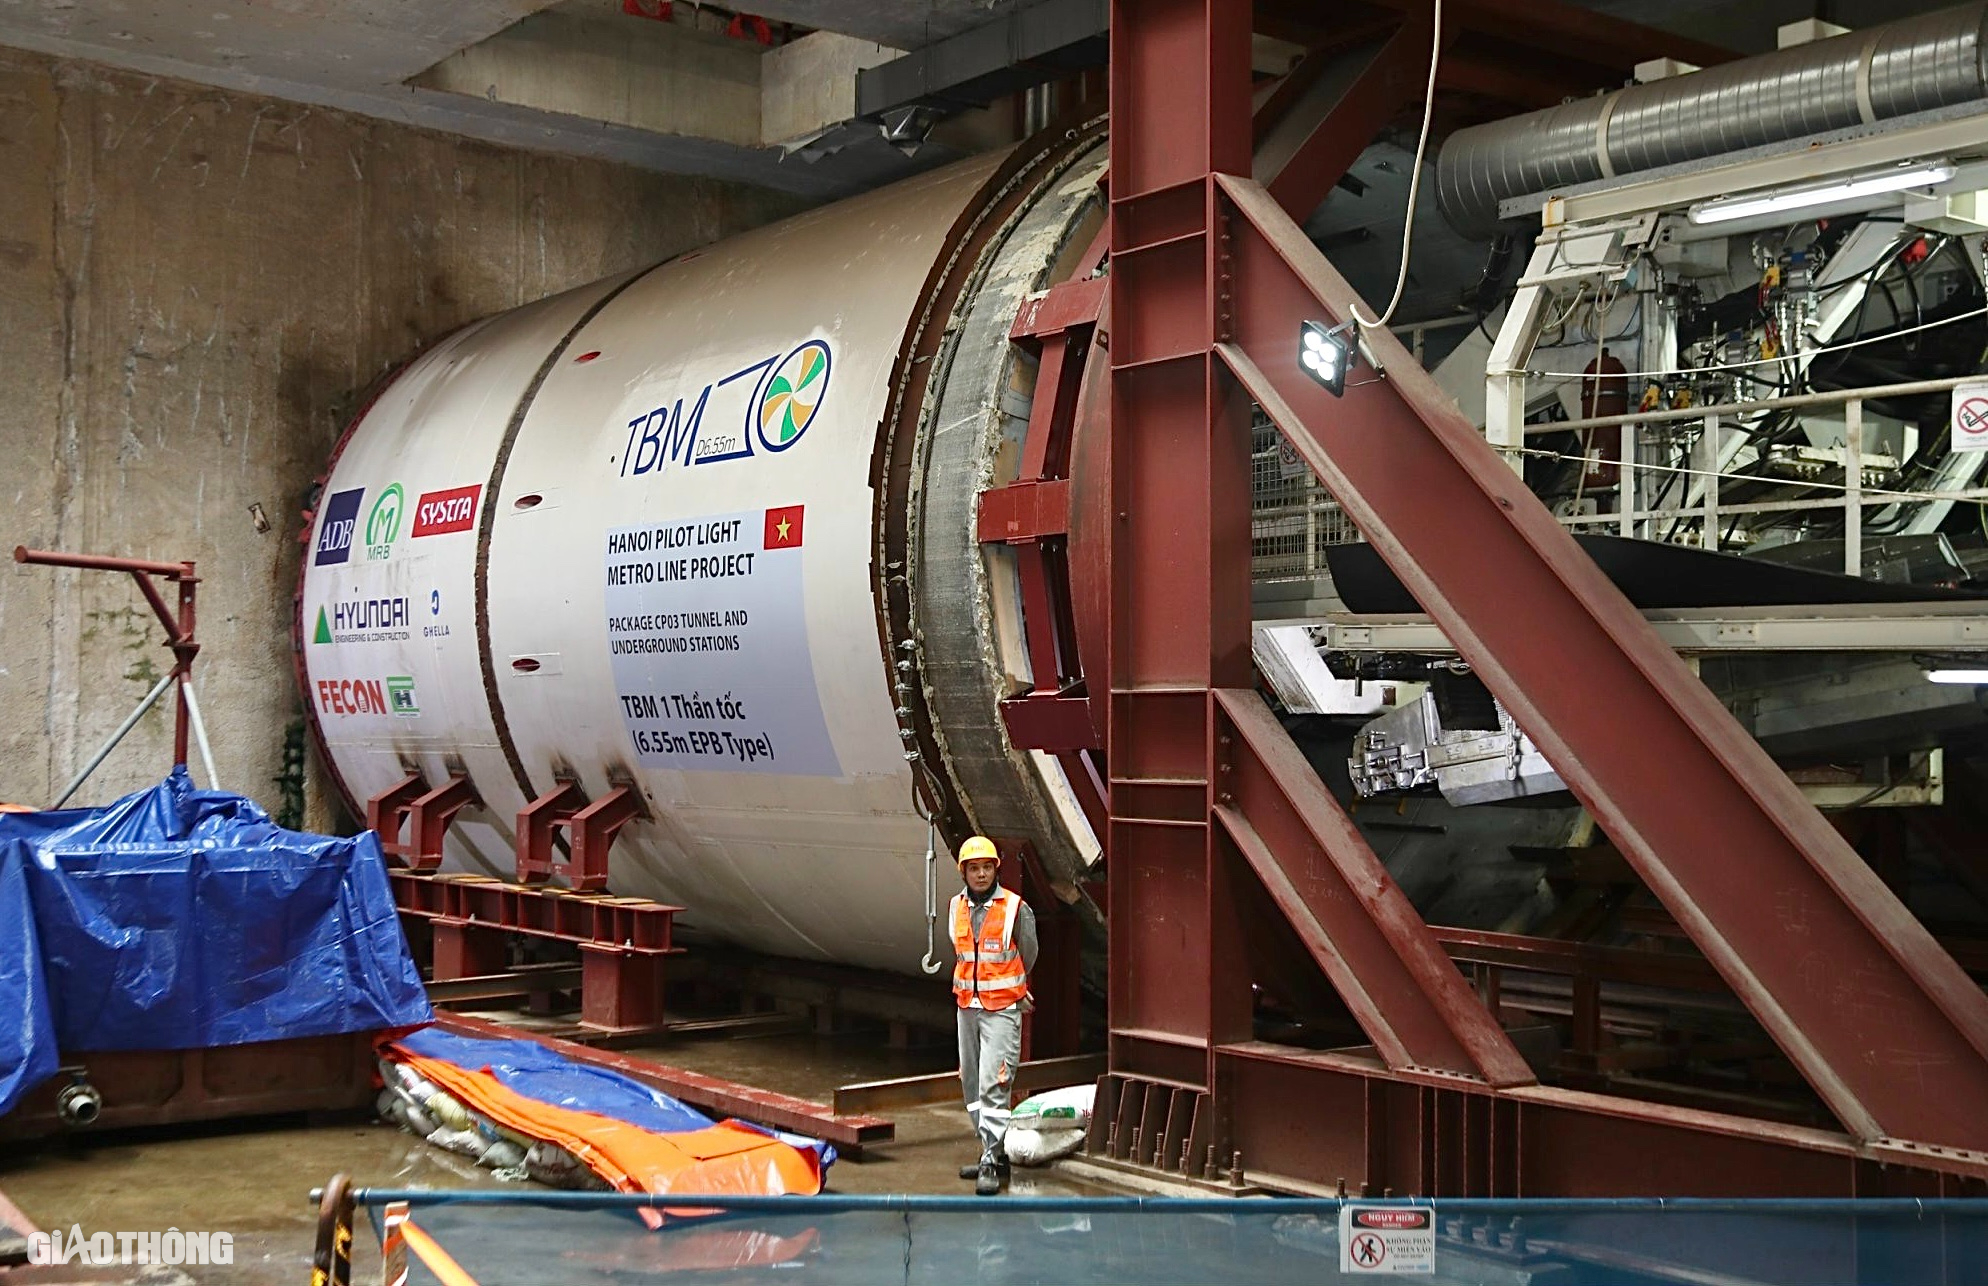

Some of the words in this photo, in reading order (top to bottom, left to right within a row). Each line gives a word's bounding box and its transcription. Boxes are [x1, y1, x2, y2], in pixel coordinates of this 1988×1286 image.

[620, 384, 713, 478] TBM
[695, 436, 736, 457] D6.55m
[420, 496, 472, 527] SYSTRA
[318, 519, 354, 552] ADB
[608, 530, 652, 554] HANOI
[655, 526, 695, 550] PILOT
[697, 520, 741, 545] LIGHT
[367, 545, 390, 561] MRB
[607, 563, 653, 586] METRO
[657, 559, 687, 582] LINE
[691, 553, 755, 579] PROJECT
[334, 597, 409, 630] HYUNDAI
[609, 615, 652, 632] PACKAGE
[655, 614, 679, 630] CP03
[680, 611, 722, 628] TUNNEL
[724, 609, 748, 627] AND
[423, 626, 450, 638] GHELLA
[611, 637, 687, 655] UNDERGROUND
[689, 635, 740, 652] STATIONS
[317, 679, 387, 714] FECON
[621, 695, 659, 719] TBM
[660, 696, 671, 719] 1
[671, 691, 712, 719] Thần
[716, 691, 746, 720] tốc
[632, 730, 689, 756] (6.55m
[689, 731, 721, 755] EPB
[722, 731, 775, 762] Type)
